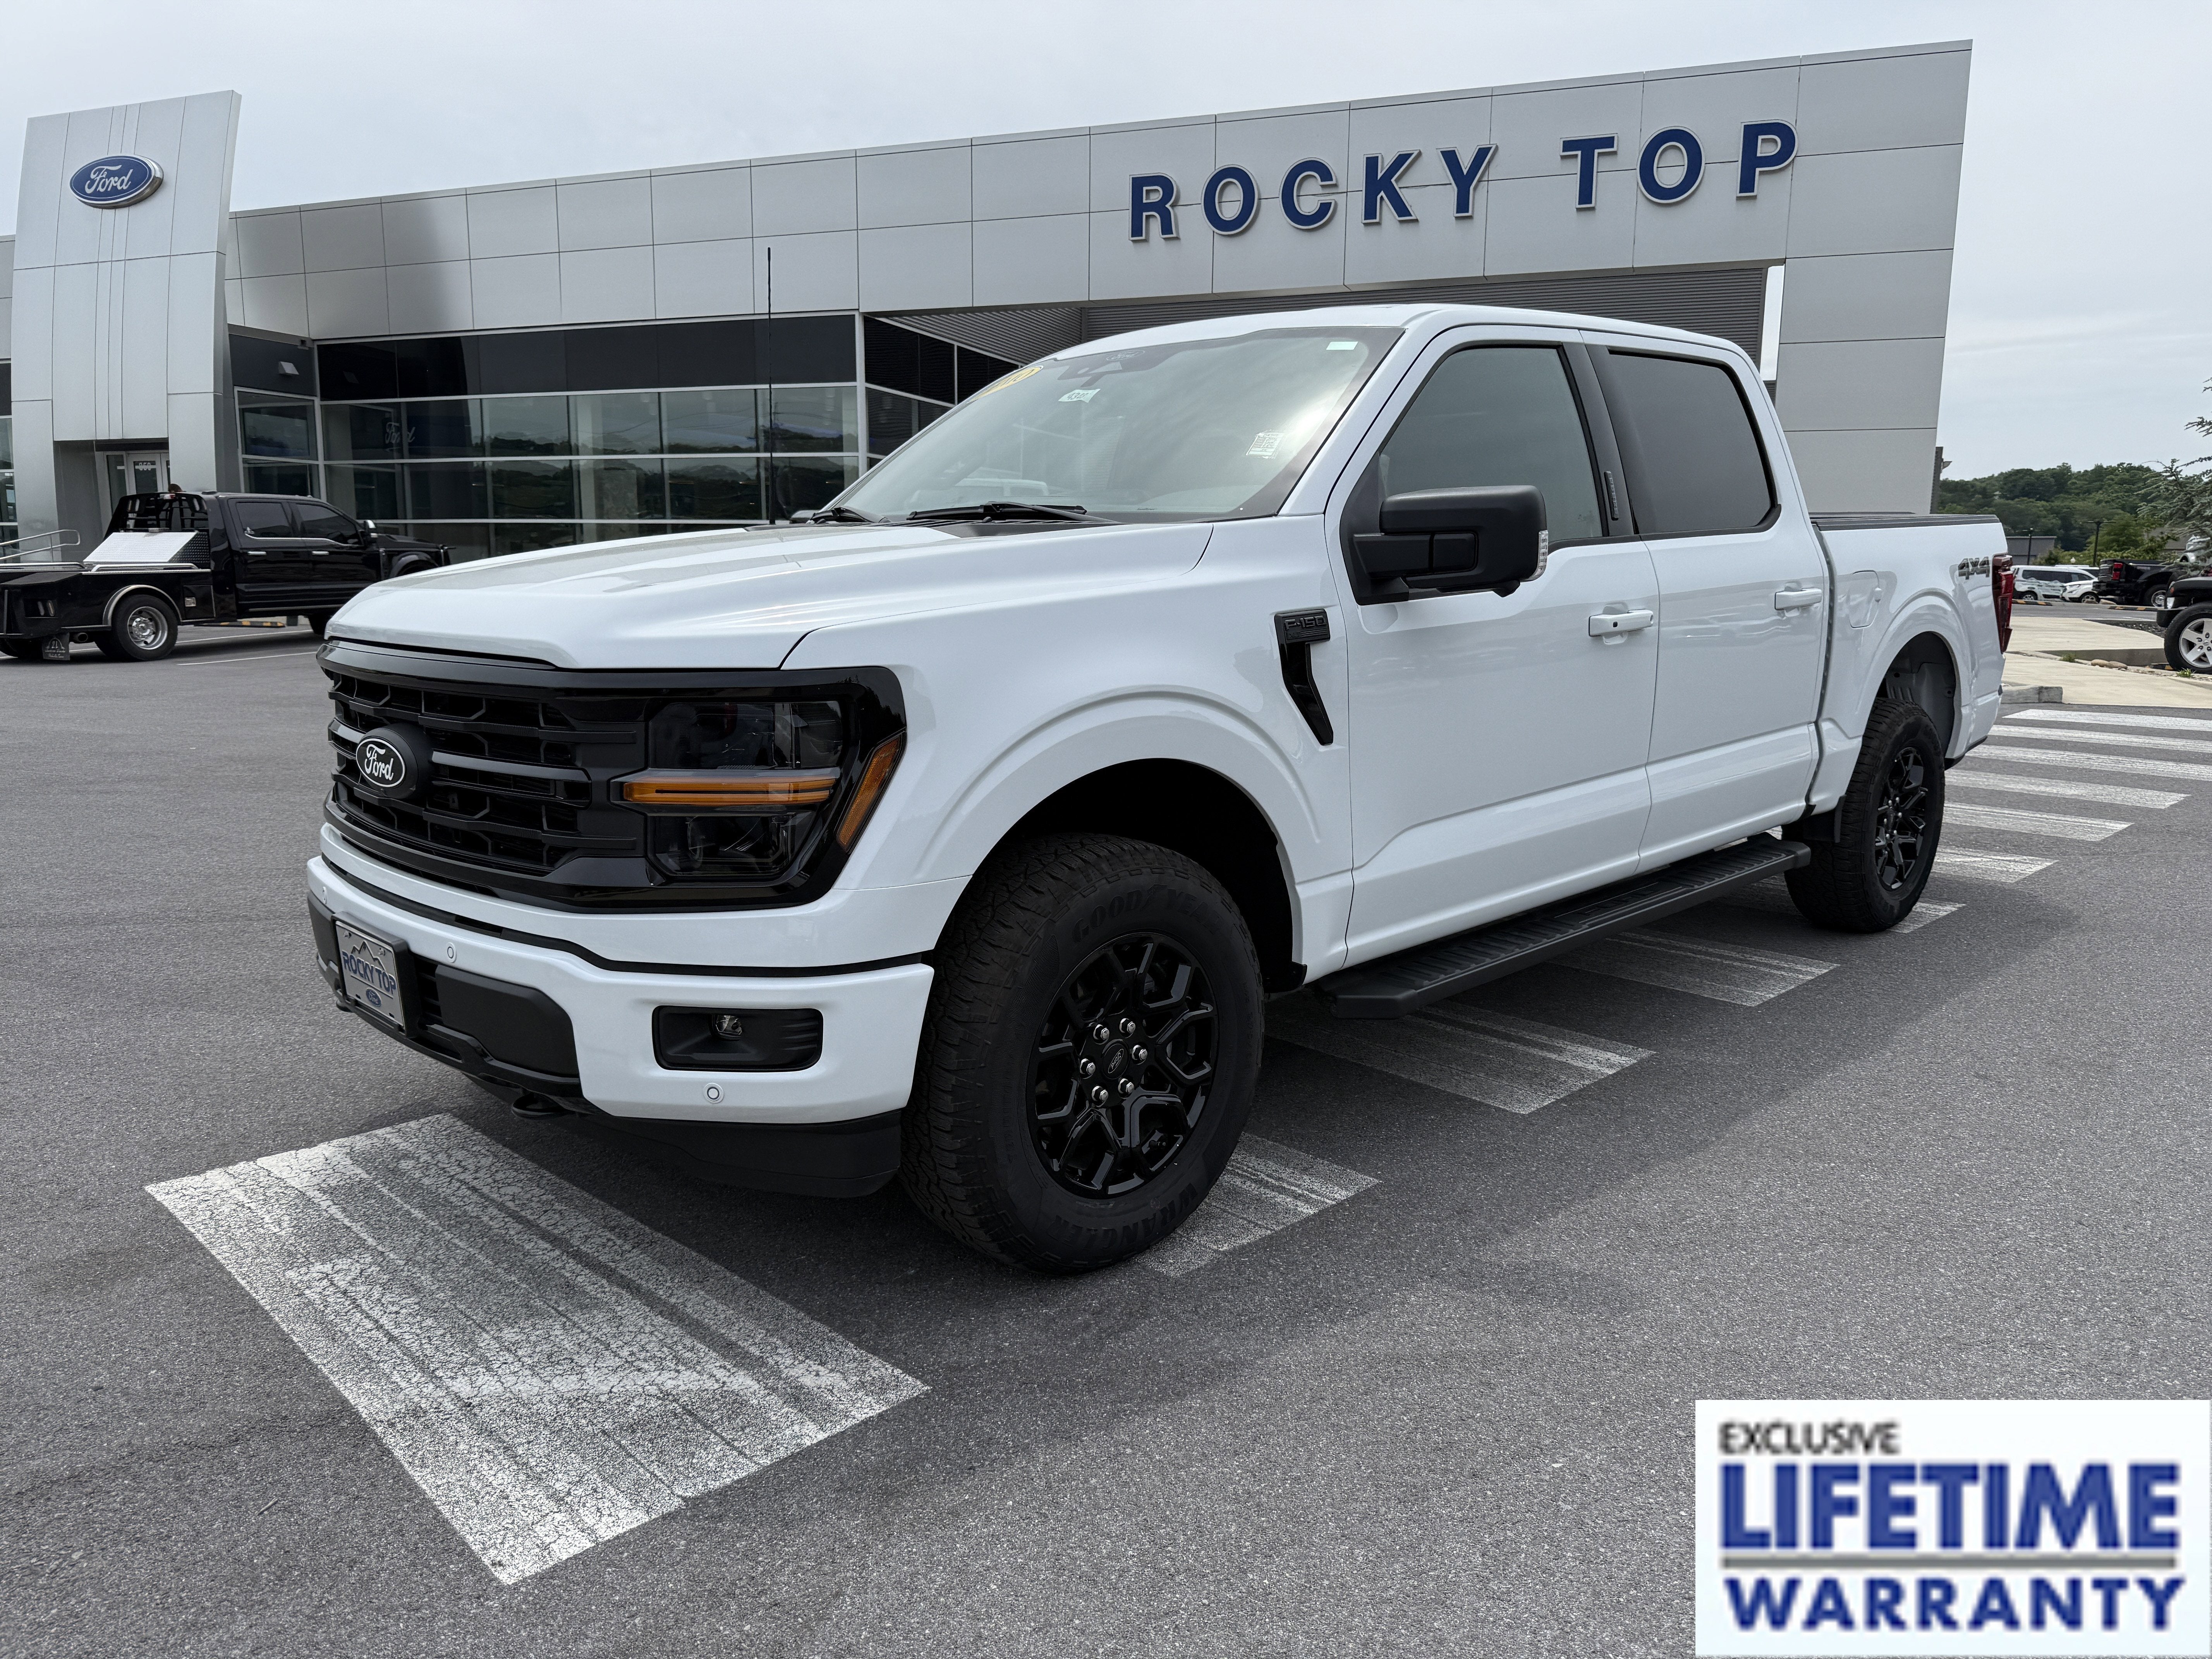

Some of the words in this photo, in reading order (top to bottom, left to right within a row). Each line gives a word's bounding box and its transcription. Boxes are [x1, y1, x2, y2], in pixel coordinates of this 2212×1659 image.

[85, 165, 133, 194] Ford
[1129, 144, 1497, 240] ROCKY
[1560, 120, 1798, 209] TOP
[1285, 615, 1327, 630] F-150
[364, 744, 394, 781] Ford
[342, 950, 374, 984] ROCKY
[375, 966, 397, 996] TOP
[1047, 1182, 1199, 1250] WRANGLER
